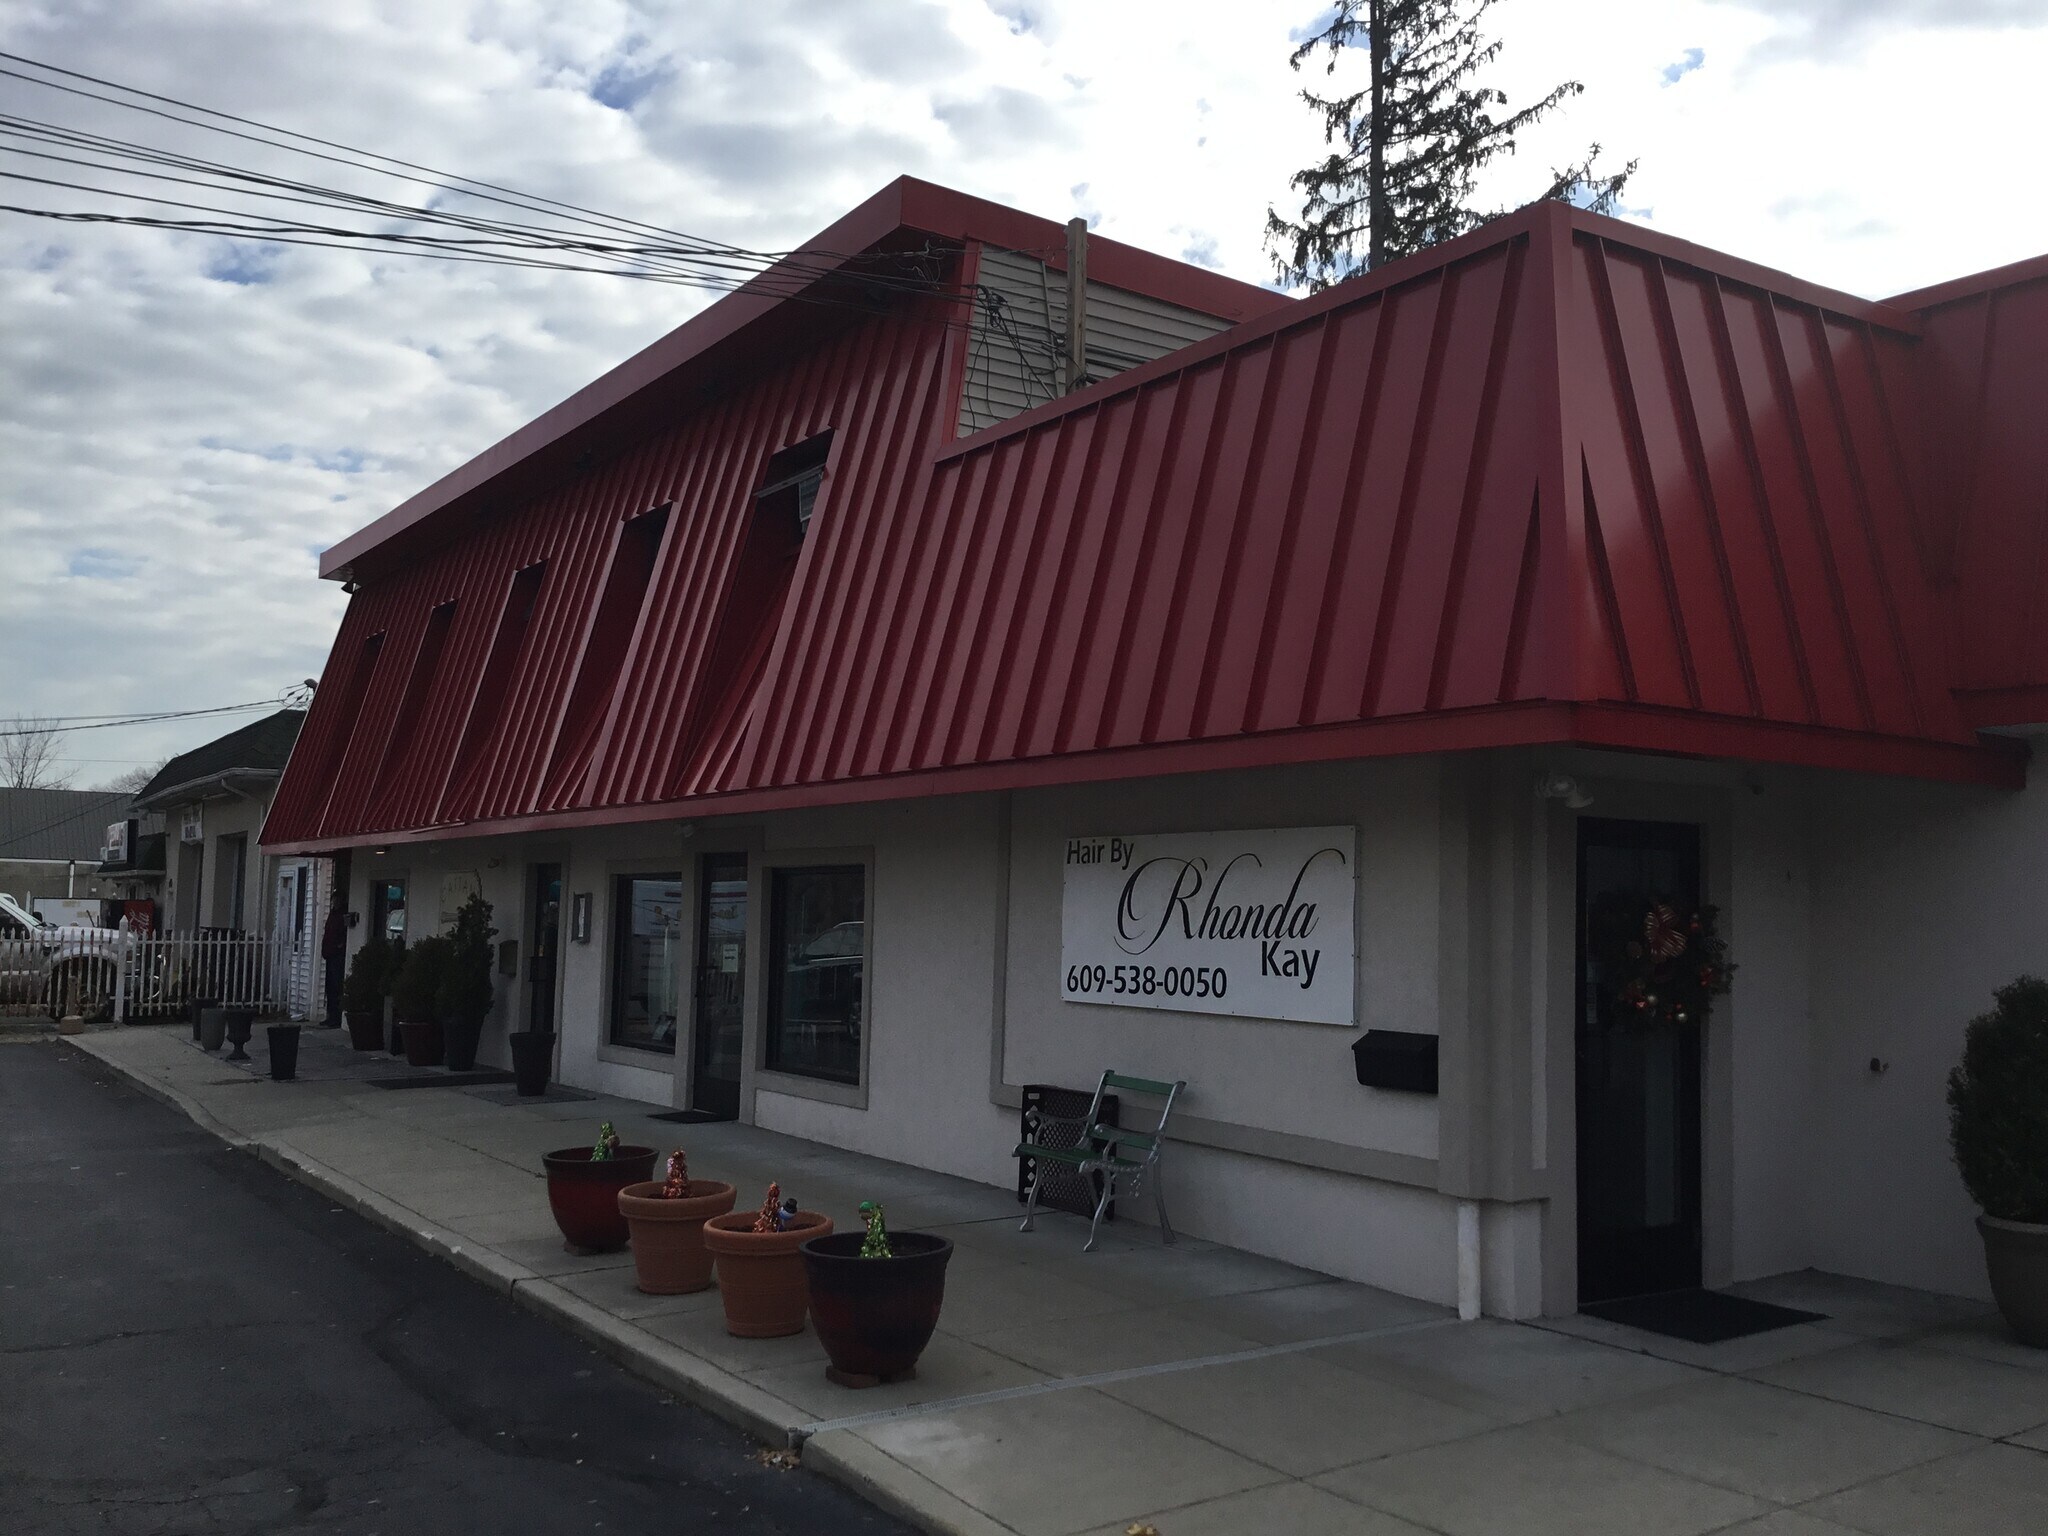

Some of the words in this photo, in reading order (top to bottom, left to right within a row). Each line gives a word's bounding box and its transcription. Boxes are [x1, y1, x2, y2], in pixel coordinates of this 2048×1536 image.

[1066, 840, 1105, 865] Hair
[1110, 837, 1134, 871] By
[1113, 848, 1346, 956] Rhonda
[1066, 964, 1228, 999] 609-538-0050
[1261, 939, 1321, 990] Kay
